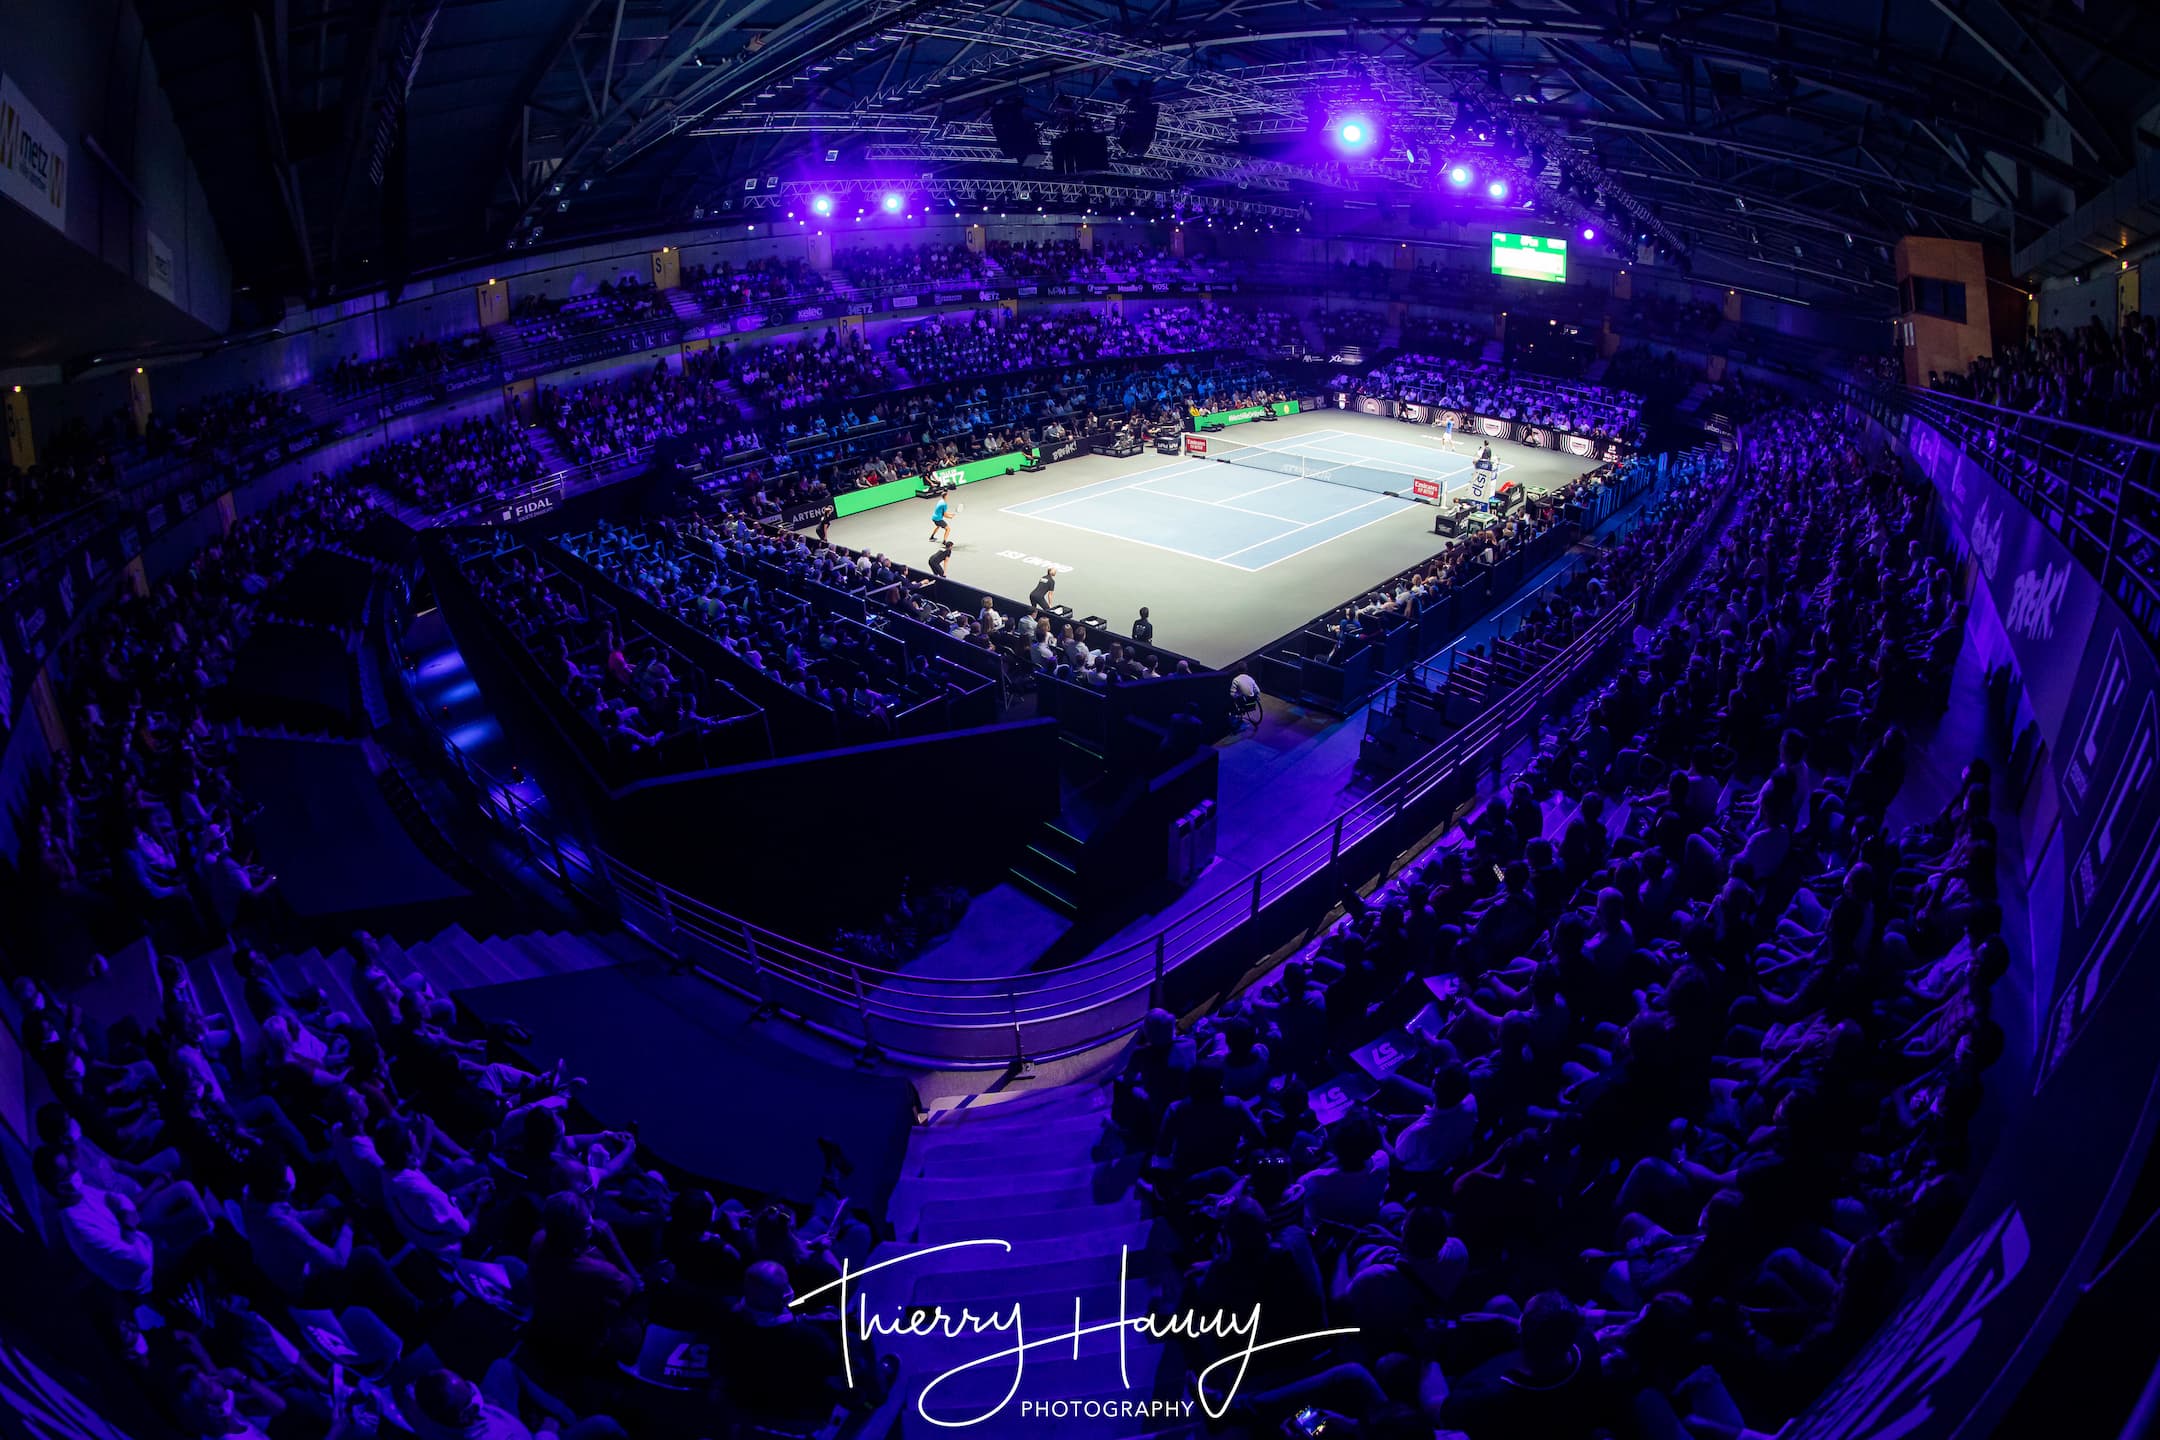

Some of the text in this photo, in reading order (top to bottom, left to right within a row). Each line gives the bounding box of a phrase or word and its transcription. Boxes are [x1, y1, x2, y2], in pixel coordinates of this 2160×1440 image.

[20, 130, 48, 179] metz
[655, 257, 662, 273] S
[842, 319, 848, 335] R
[515, 498, 553, 517] FIDAL
